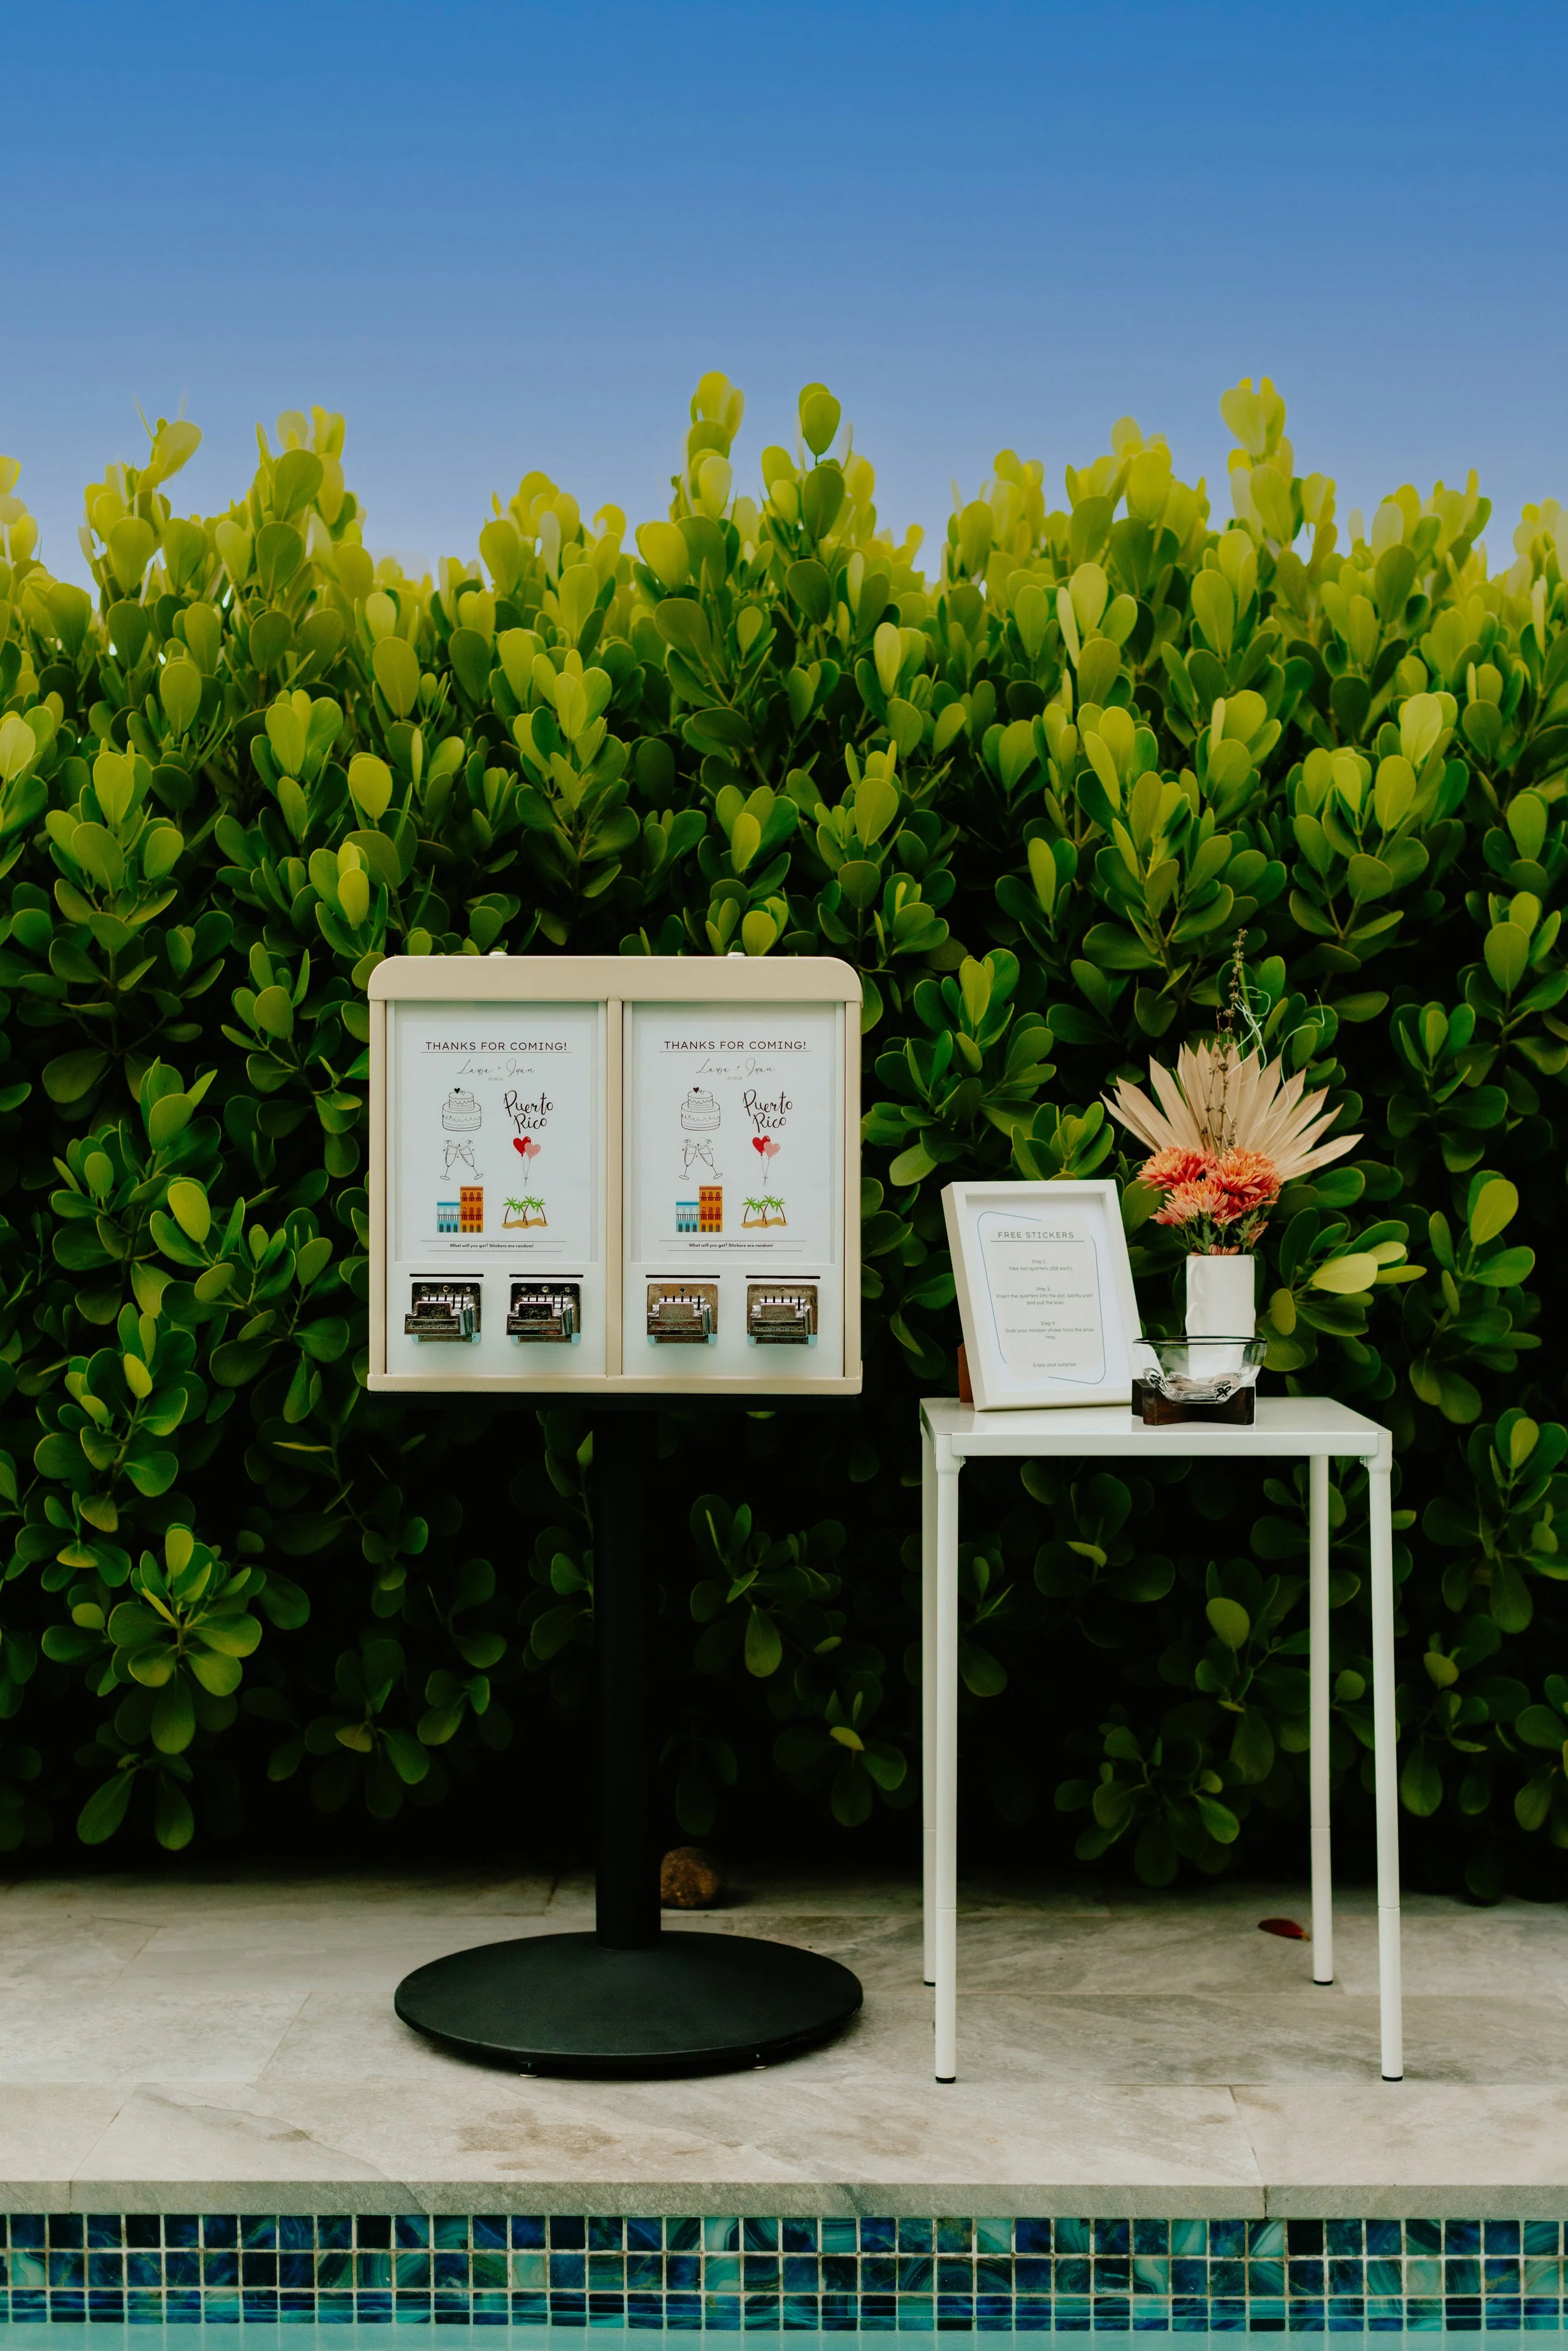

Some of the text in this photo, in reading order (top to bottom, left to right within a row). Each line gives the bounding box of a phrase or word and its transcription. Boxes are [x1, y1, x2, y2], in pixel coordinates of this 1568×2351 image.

[425, 1041, 567, 1051] THANKS FOR COMING!
[664, 1041, 806, 1050] THANKS FOR COMING!
[457, 1059, 493, 1076] Laura
[506, 1058, 536, 1078] Juan
[696, 1058, 733, 1075] Laura
[745, 1058, 775, 1077] Juan
[504, 1090, 554, 1117] Puerto
[743, 1090, 793, 1117] Puerto
[514, 1113, 547, 1134] Rico
[753, 1112, 787, 1133] Rico
